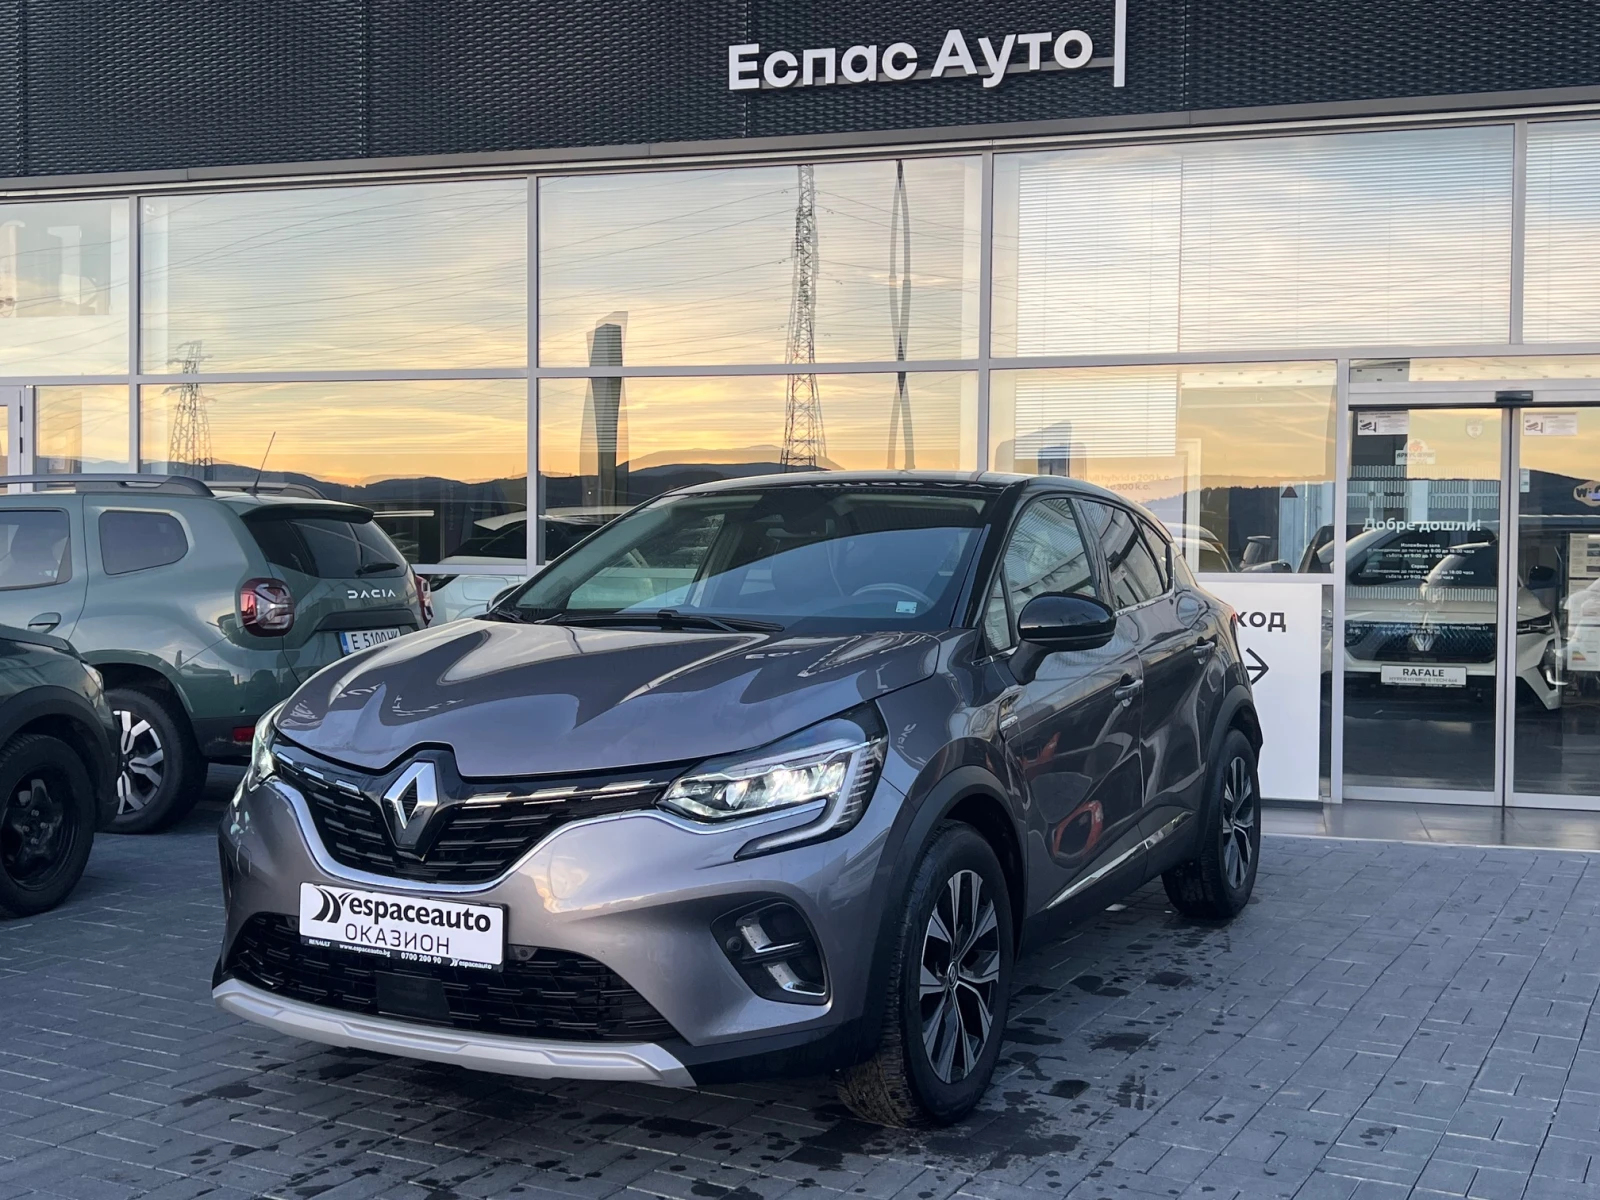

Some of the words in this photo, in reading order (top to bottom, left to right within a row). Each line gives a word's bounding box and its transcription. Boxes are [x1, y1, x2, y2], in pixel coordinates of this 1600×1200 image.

[729, 42, 918, 90] Еспас
[931, 29, 1094, 88] Ауто
[1362, 517, 1415, 533] Добре
[1418, 519, 1481, 533] дошли!
[347, 589, 396, 599] DACIA
[1236, 611, 1287, 632] ход
[1402, 668, 1445, 677] RAFALE
[349, 896, 492, 933] espaceauto
[345, 923, 450, 955] ОКАЗИОН
[308, 938, 331, 948] RENAULT
[339, 943, 391, 958] www.espaceauto.bg
[400, 952, 418, 962] 0700
[418, 954, 432, 963] 200
[432, 955, 442, 965] 90
[458, 960, 492, 970] espaceauto
